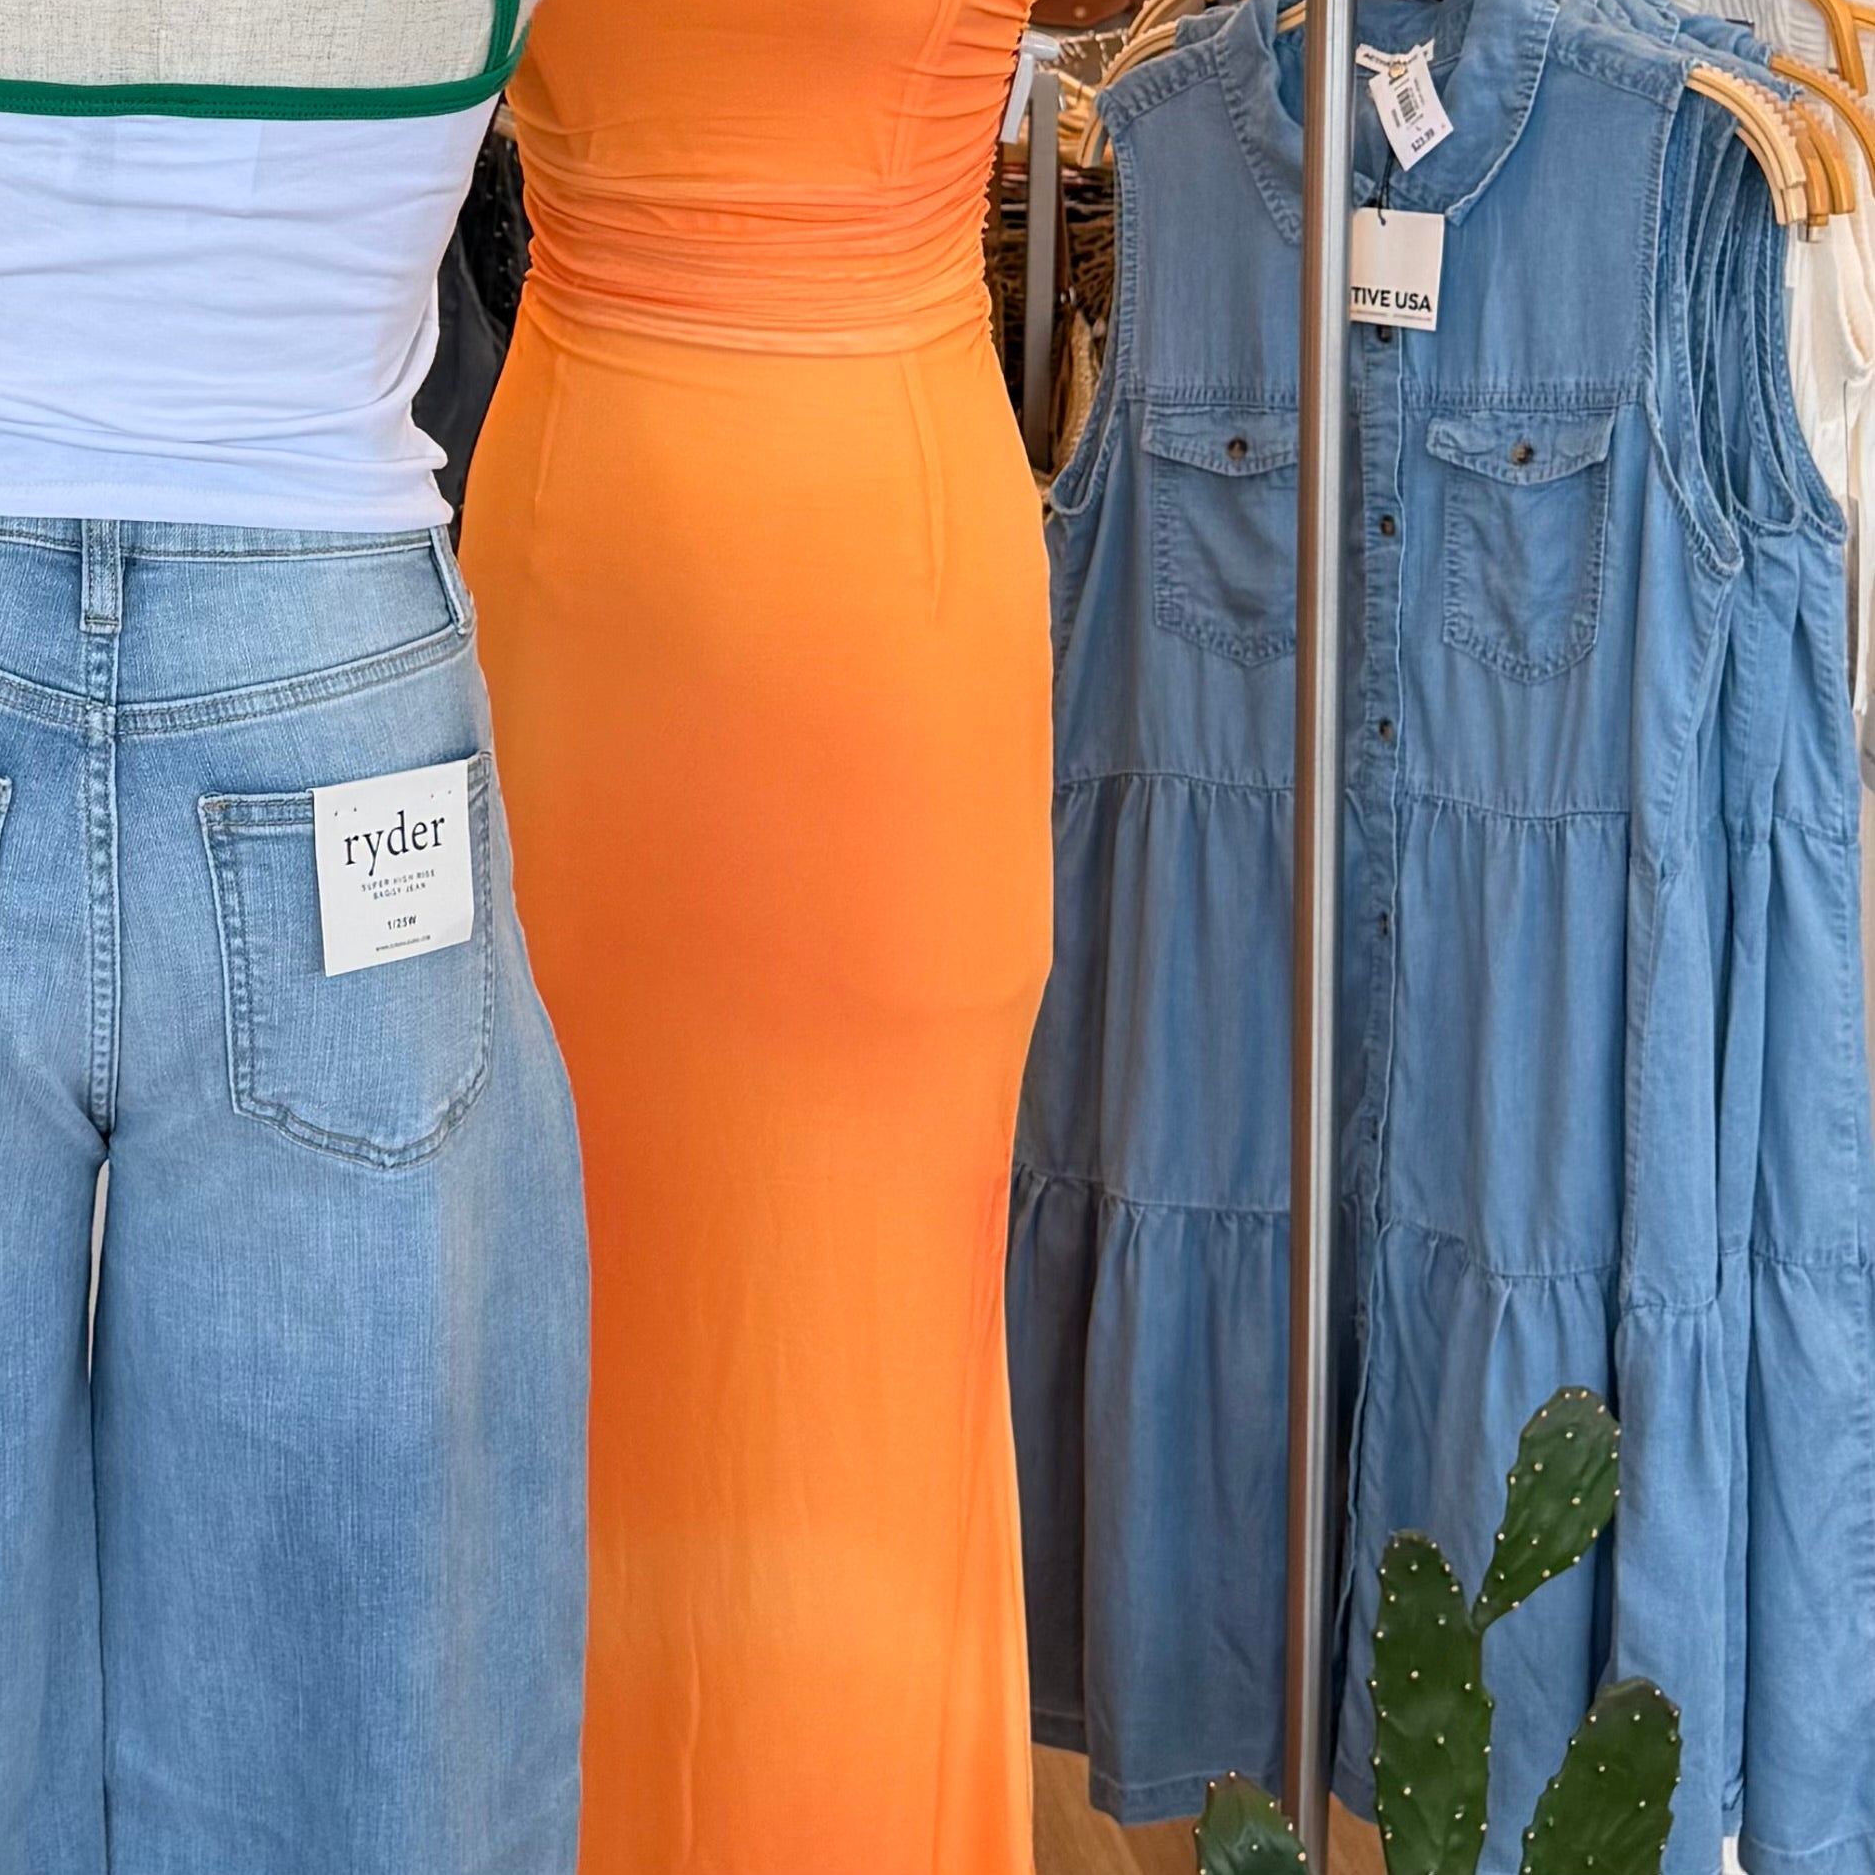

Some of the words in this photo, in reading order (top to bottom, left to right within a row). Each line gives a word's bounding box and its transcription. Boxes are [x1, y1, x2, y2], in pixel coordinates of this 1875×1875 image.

[1351, 286, 1391, 308] TIVE
[1395, 290, 1432, 313] USA
[343, 810, 445, 877] ryder
